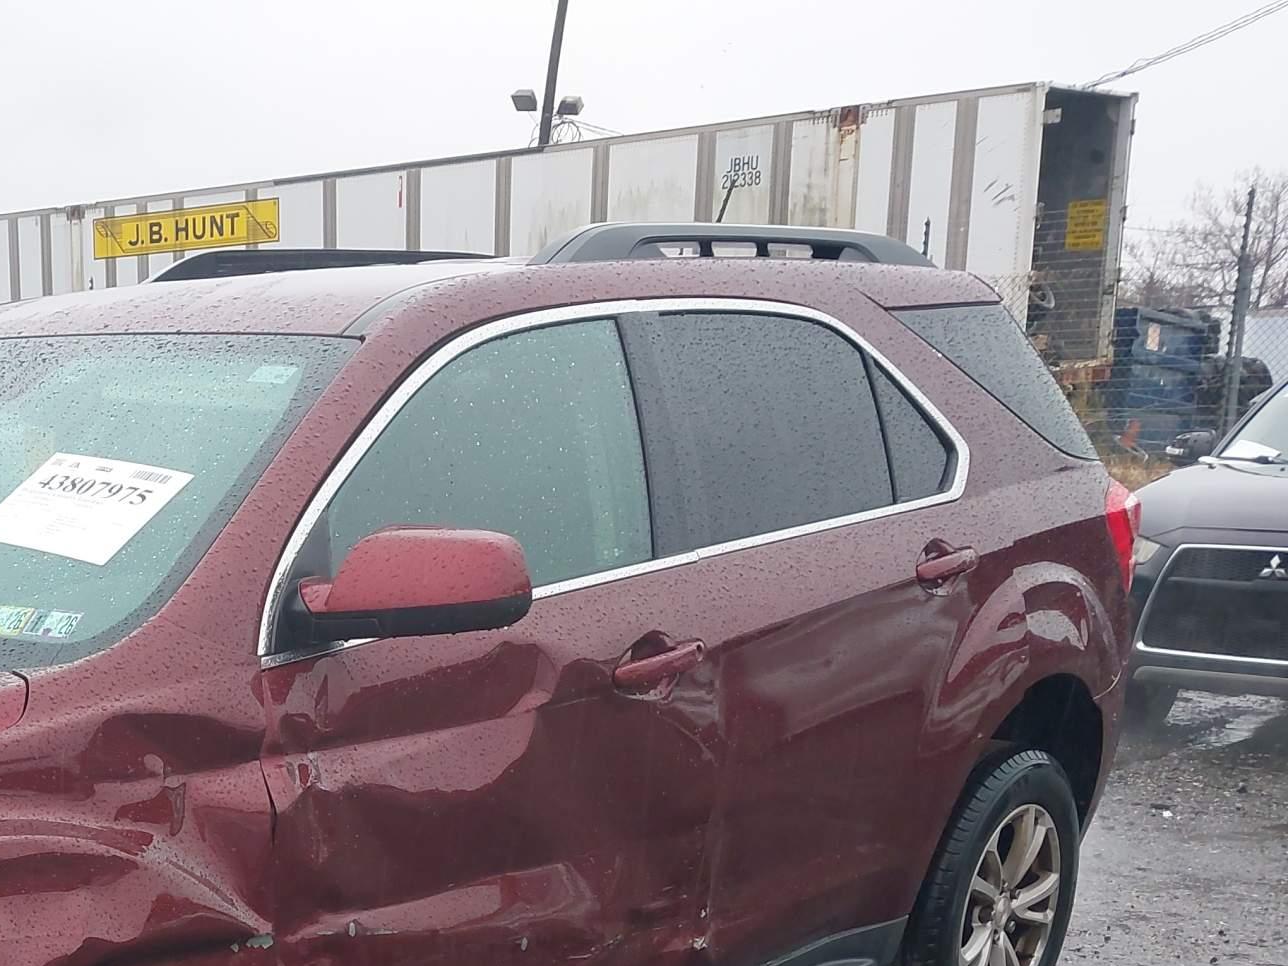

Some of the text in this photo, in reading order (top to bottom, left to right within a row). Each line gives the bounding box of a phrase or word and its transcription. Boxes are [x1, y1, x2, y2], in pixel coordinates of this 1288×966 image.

[727, 155, 758, 174] JBHU
[175, 212, 240, 241] HUNT
[38, 474, 154, 505] 43807975
